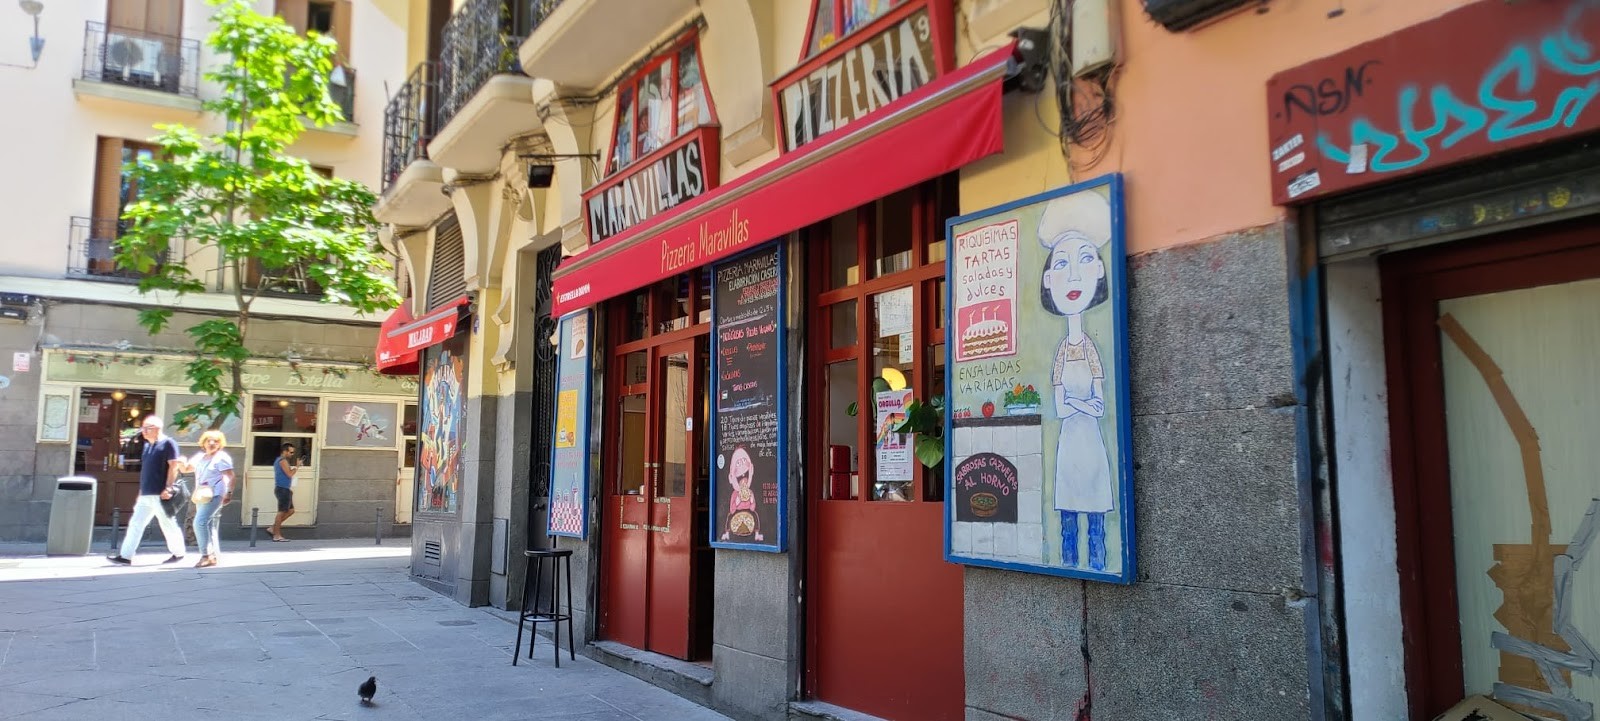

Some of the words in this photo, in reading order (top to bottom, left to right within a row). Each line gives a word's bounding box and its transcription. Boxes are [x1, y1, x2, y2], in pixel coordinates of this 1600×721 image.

[780, 18, 929, 152] PIZZERIA
[589, 141, 703, 242] MARAVILLAS
[660, 235, 696, 275] Pizzeria
[698, 208, 750, 263] Maravillas
[965, 247, 1010, 269] TARTAS
[962, 268, 1005, 285] saladas
[1006, 268, 1014, 280] y
[966, 284, 1005, 302] dulces
[959, 359, 1021, 381] ENSALADAS
[959, 376, 1017, 395] VARIADAS
[956, 457, 986, 484] SABROSAS
[964, 476, 977, 490] AL
[980, 472, 1010, 497] HORNO
